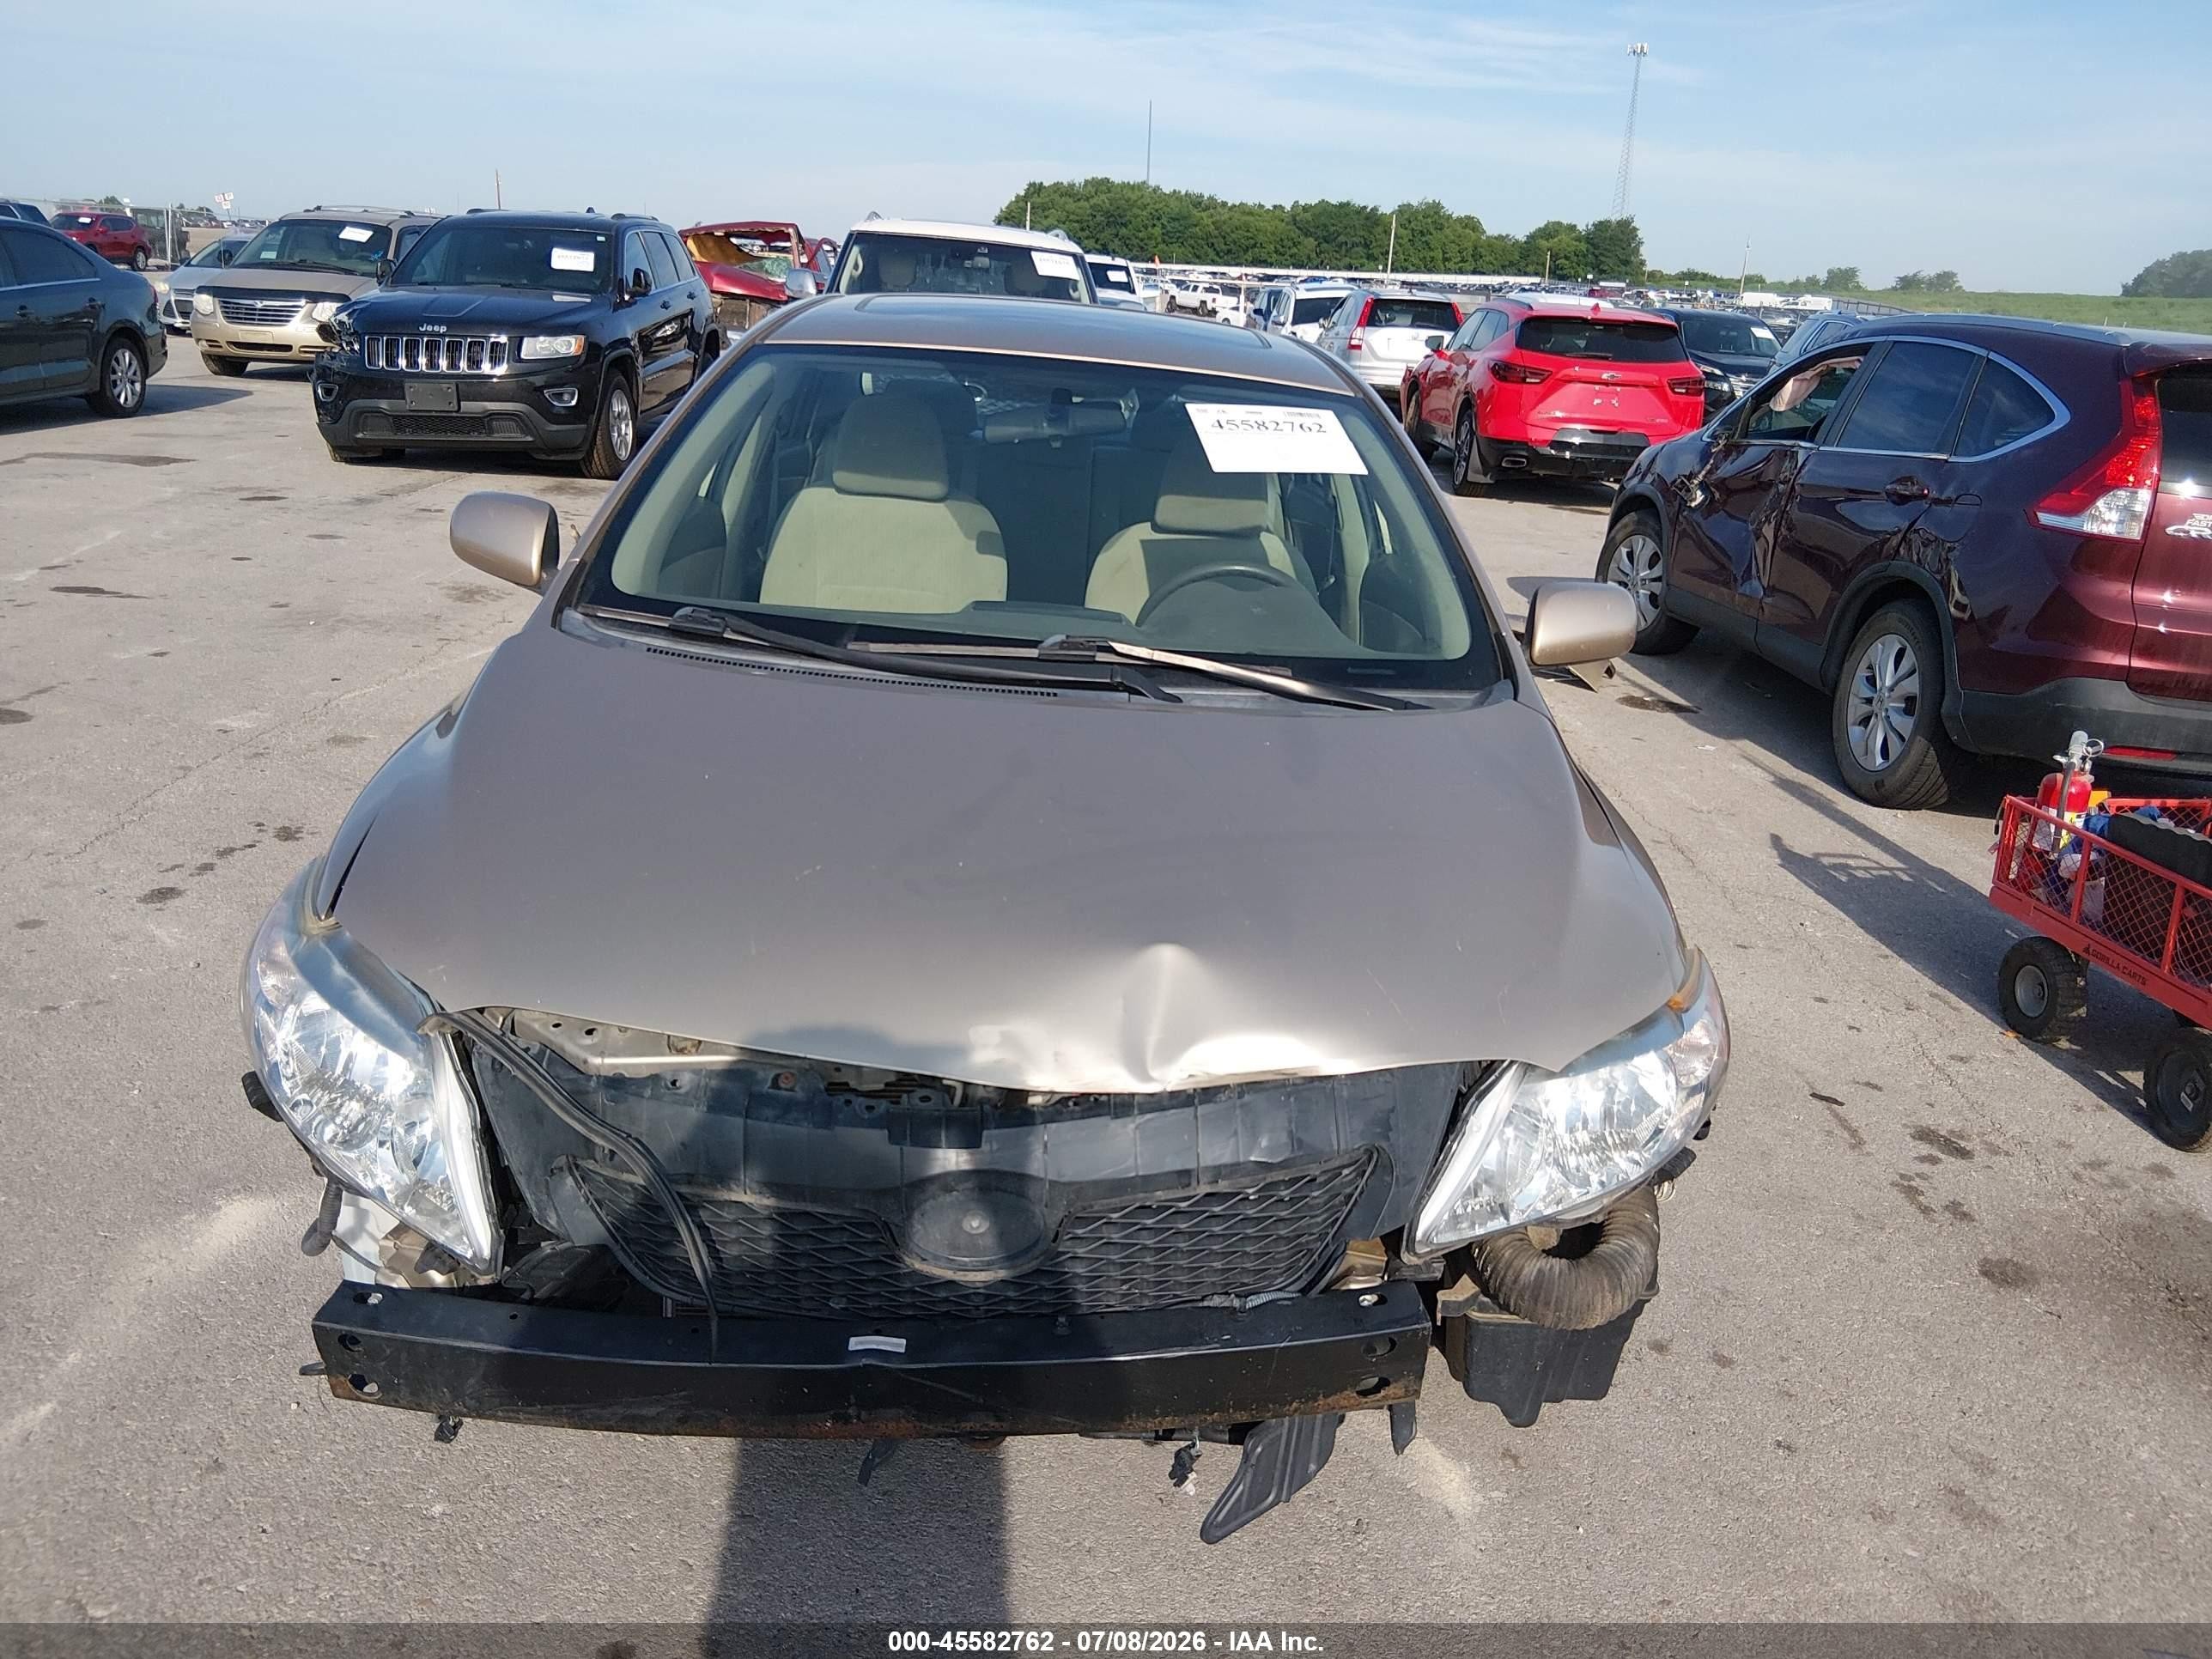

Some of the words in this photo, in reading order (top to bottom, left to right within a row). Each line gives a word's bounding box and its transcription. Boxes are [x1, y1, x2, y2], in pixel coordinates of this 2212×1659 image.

[419, 323, 447, 334] Jeep
[1212, 419, 1327, 433] 45582762
[2092, 948, 2120, 971] GORILLA
[2122, 966, 2148, 986] CARTS
